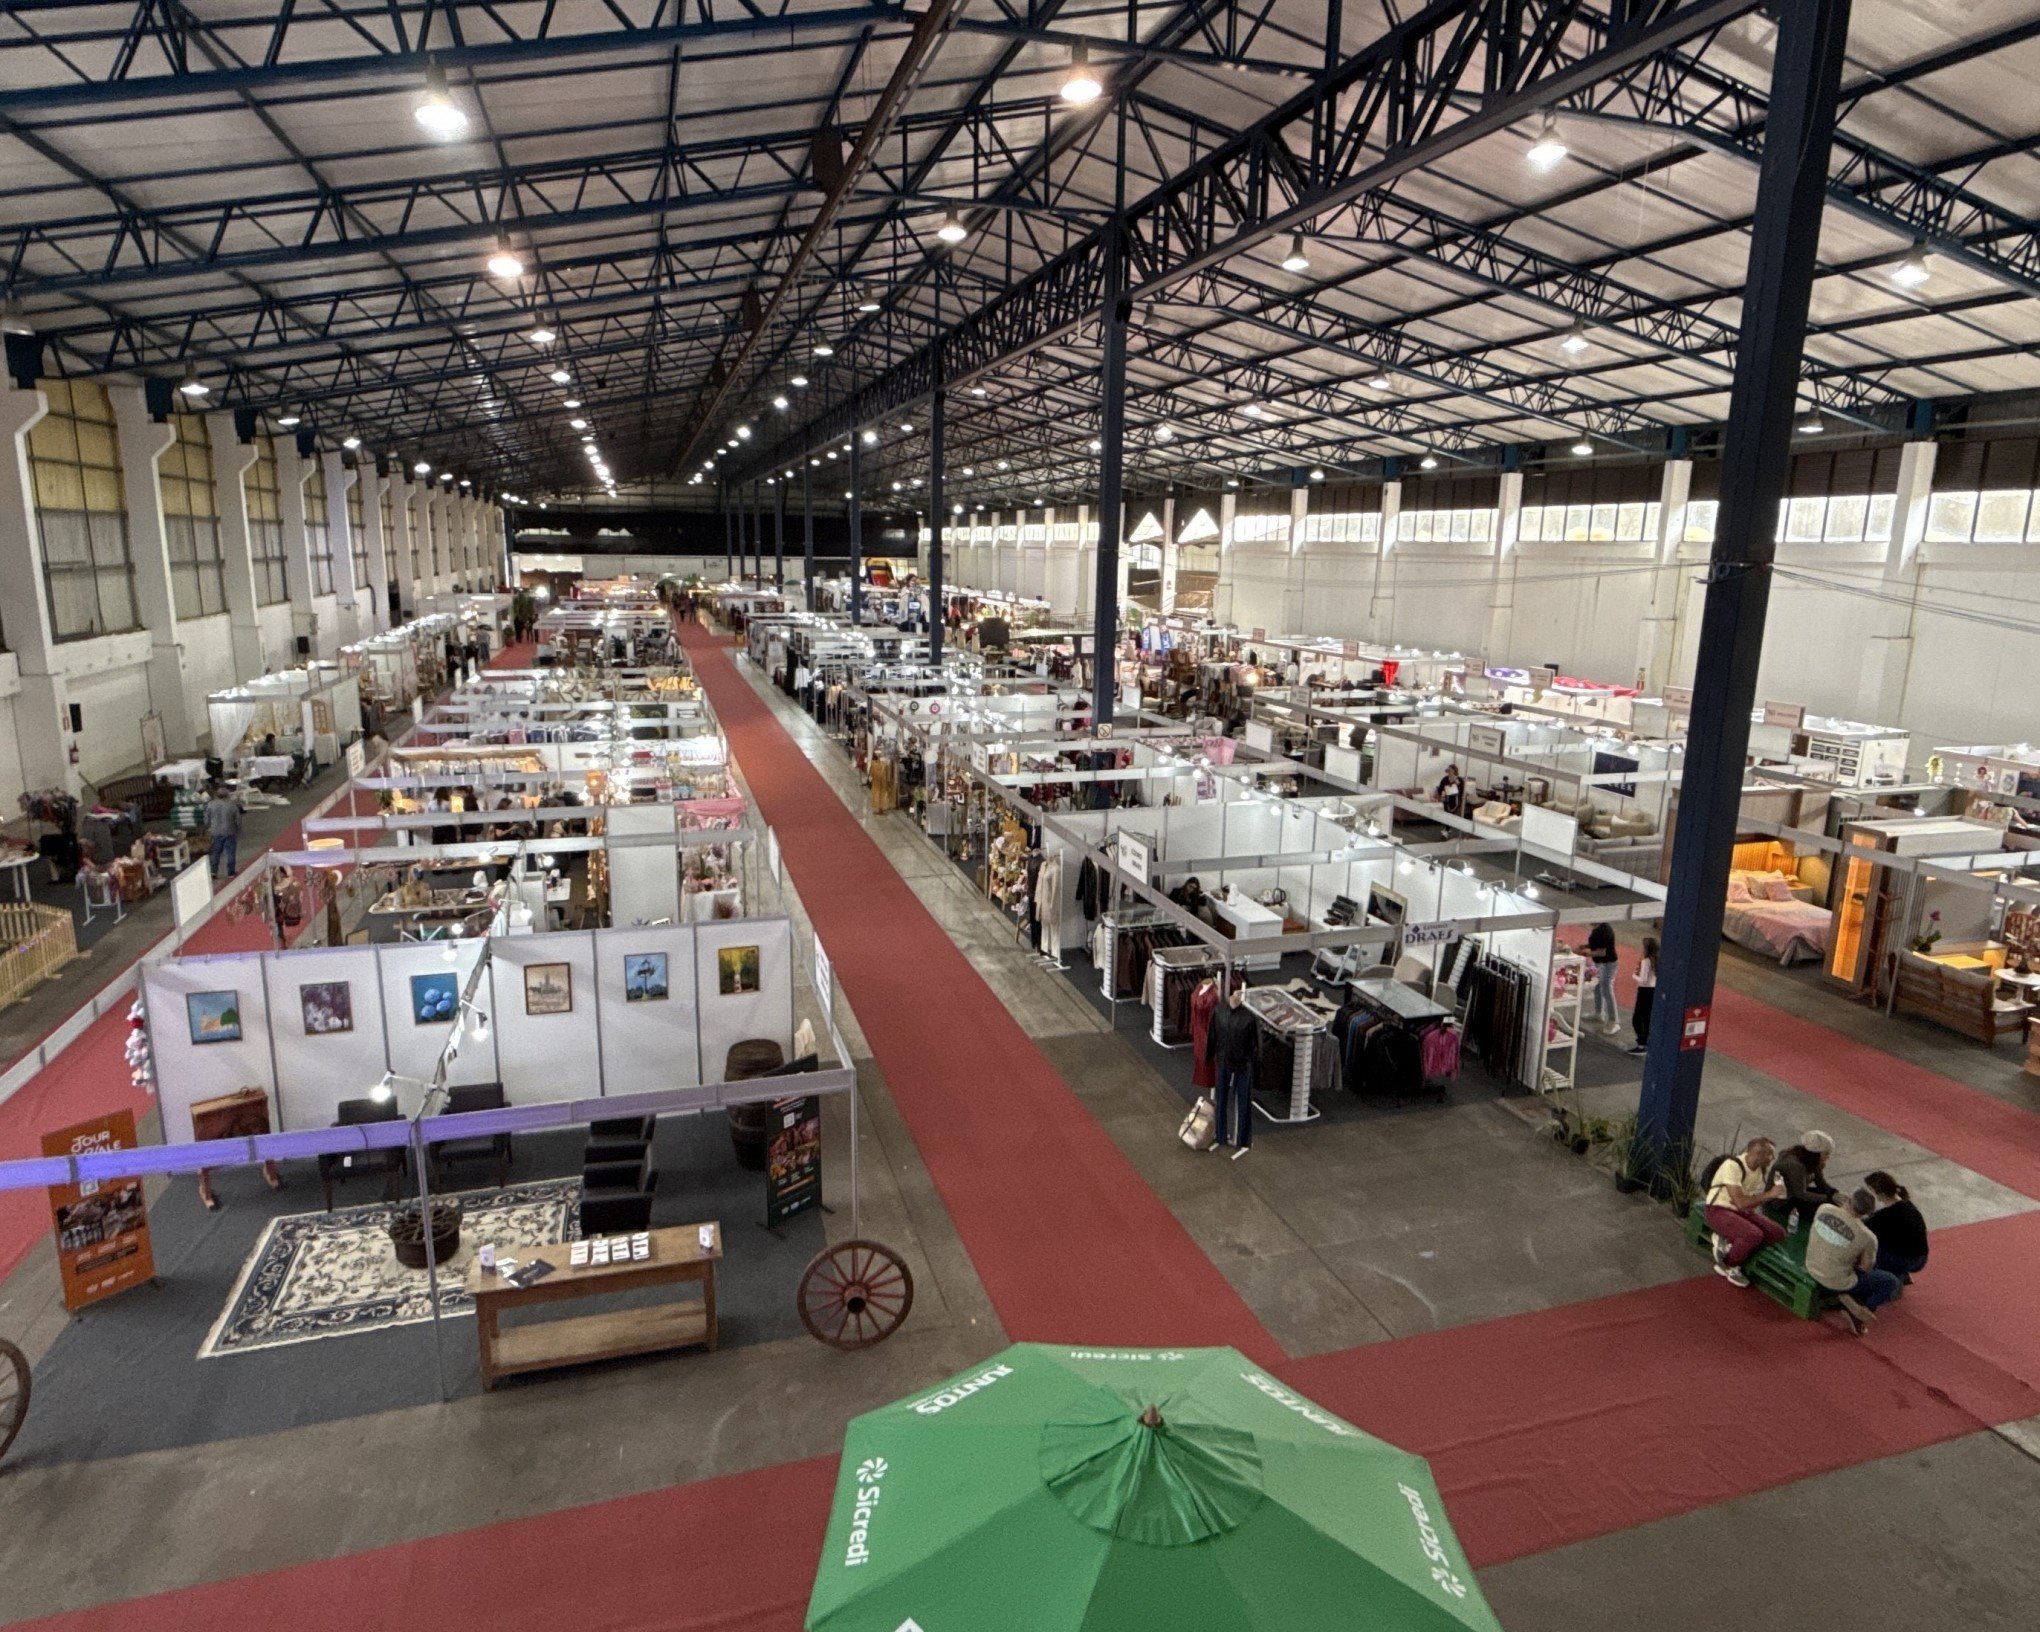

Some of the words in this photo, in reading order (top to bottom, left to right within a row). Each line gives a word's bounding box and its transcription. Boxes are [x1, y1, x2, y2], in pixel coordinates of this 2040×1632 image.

[1070, 1351, 1152, 1361] Sicredi
[915, 1365, 1014, 1415] JUNTOS
[845, 1486, 880, 1567] Sicredi
[1398, 1482, 1449, 1568] Sicredi
